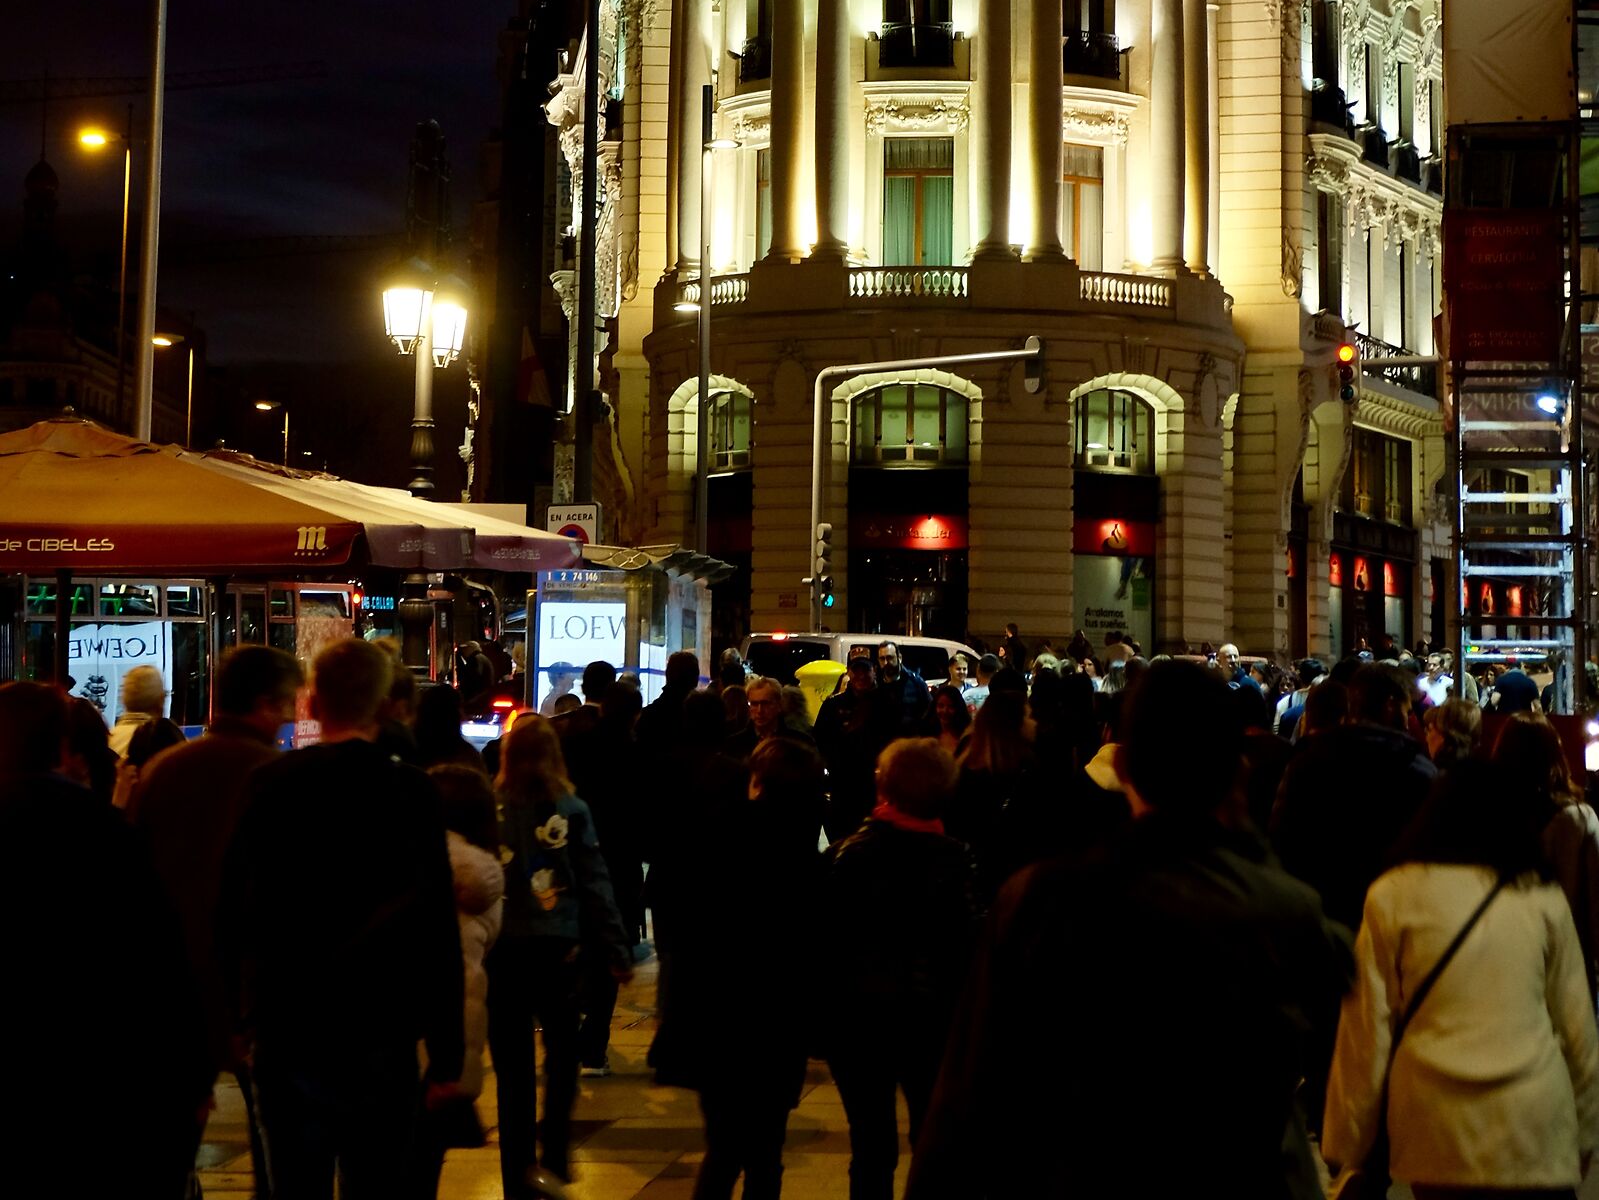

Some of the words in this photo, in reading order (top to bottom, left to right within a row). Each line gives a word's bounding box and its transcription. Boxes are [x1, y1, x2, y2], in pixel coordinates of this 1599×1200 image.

[550, 514, 562, 522] EN
[566, 513, 593, 521] ACERA
[27, 538, 115, 552] CIBELES
